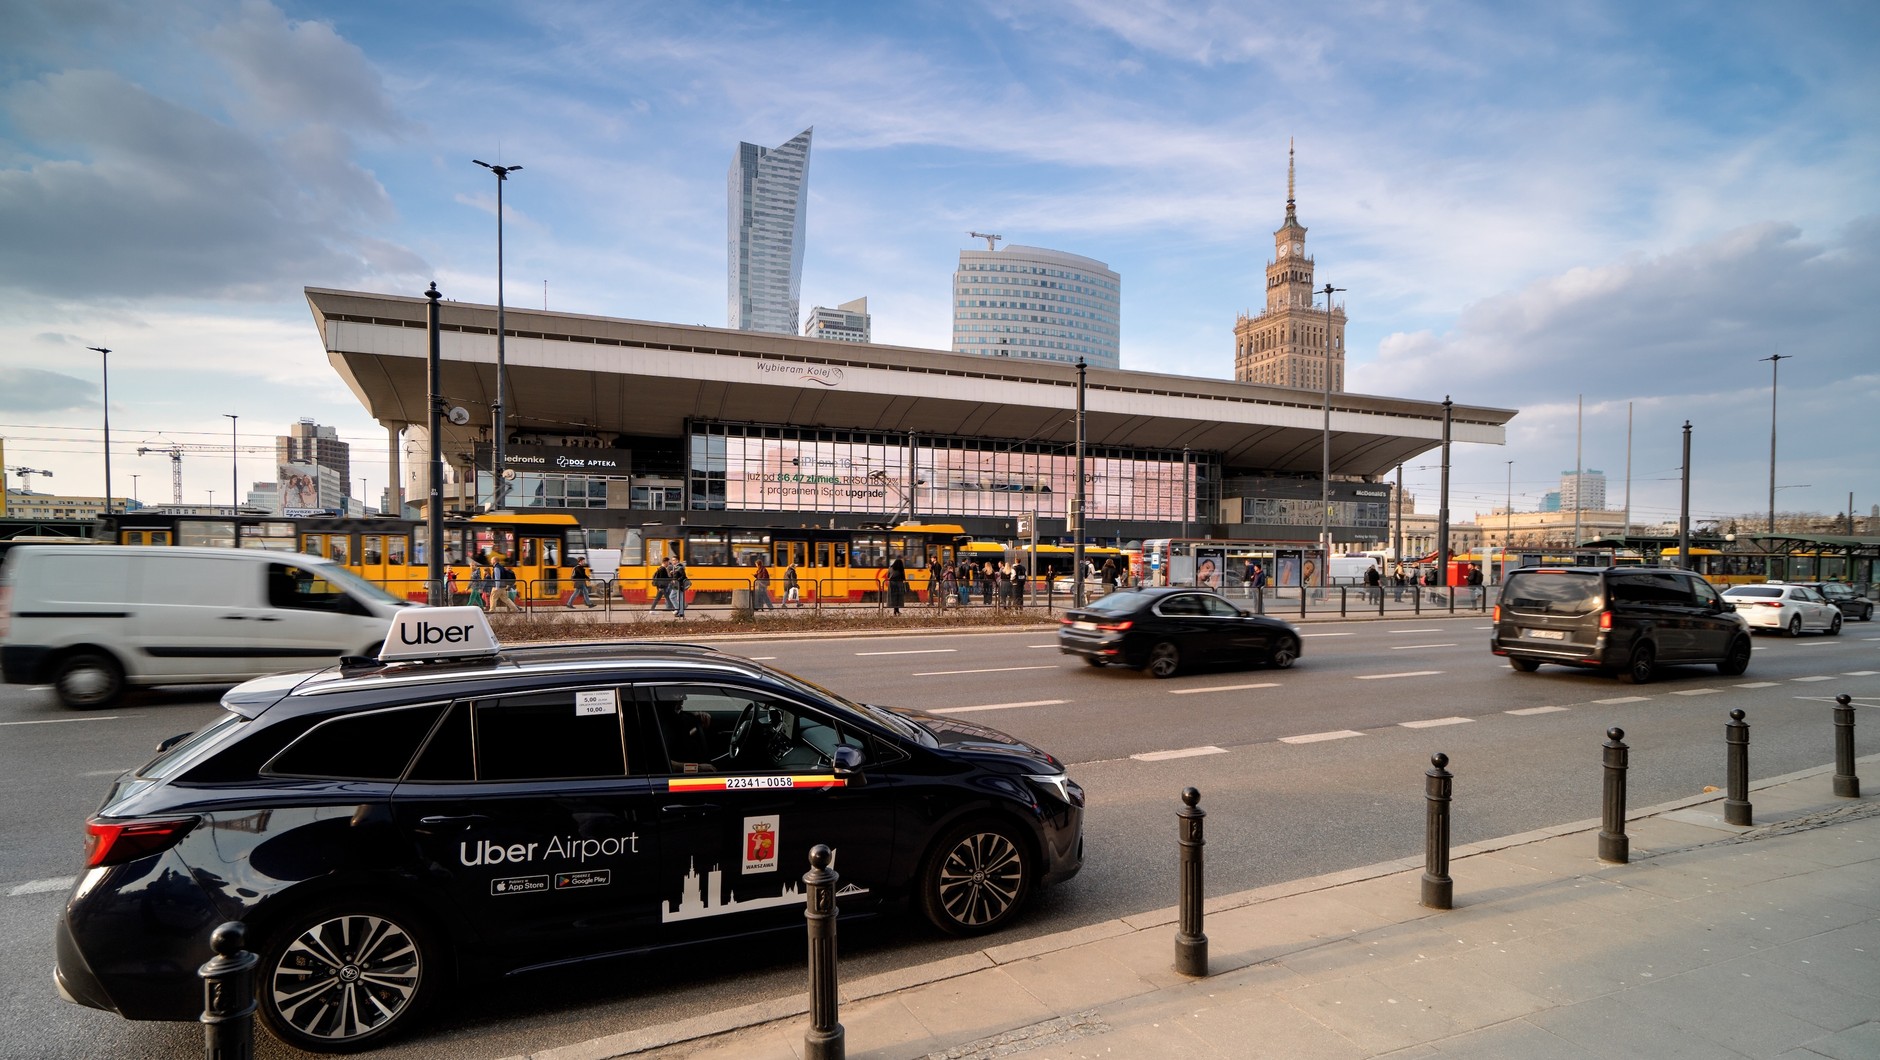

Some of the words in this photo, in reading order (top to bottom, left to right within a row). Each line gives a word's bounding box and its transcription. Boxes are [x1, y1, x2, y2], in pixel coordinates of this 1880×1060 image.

[757, 362, 803, 374] Wybieram
[807, 367, 830, 378] Kolej
[504, 455, 545, 464] iedronka
[801, 457, 838, 468] iPhone
[747, 472, 761, 482] już
[762, 473, 775, 481] od
[843, 476, 868, 485] RRSO
[1072, 469, 1102, 485] ipot
[767, 487, 817, 497] programem
[821, 487, 844, 497] iSpot
[1355, 490, 1387, 498] McDonald's
[400, 621, 475, 645] Uber
[727, 777, 793, 788] 22341-0058
[460, 839, 539, 867] Uber
[543, 831, 640, 864] Airport
[745, 862, 774, 870] WARSZAWA
[571, 877, 593, 885] Google
